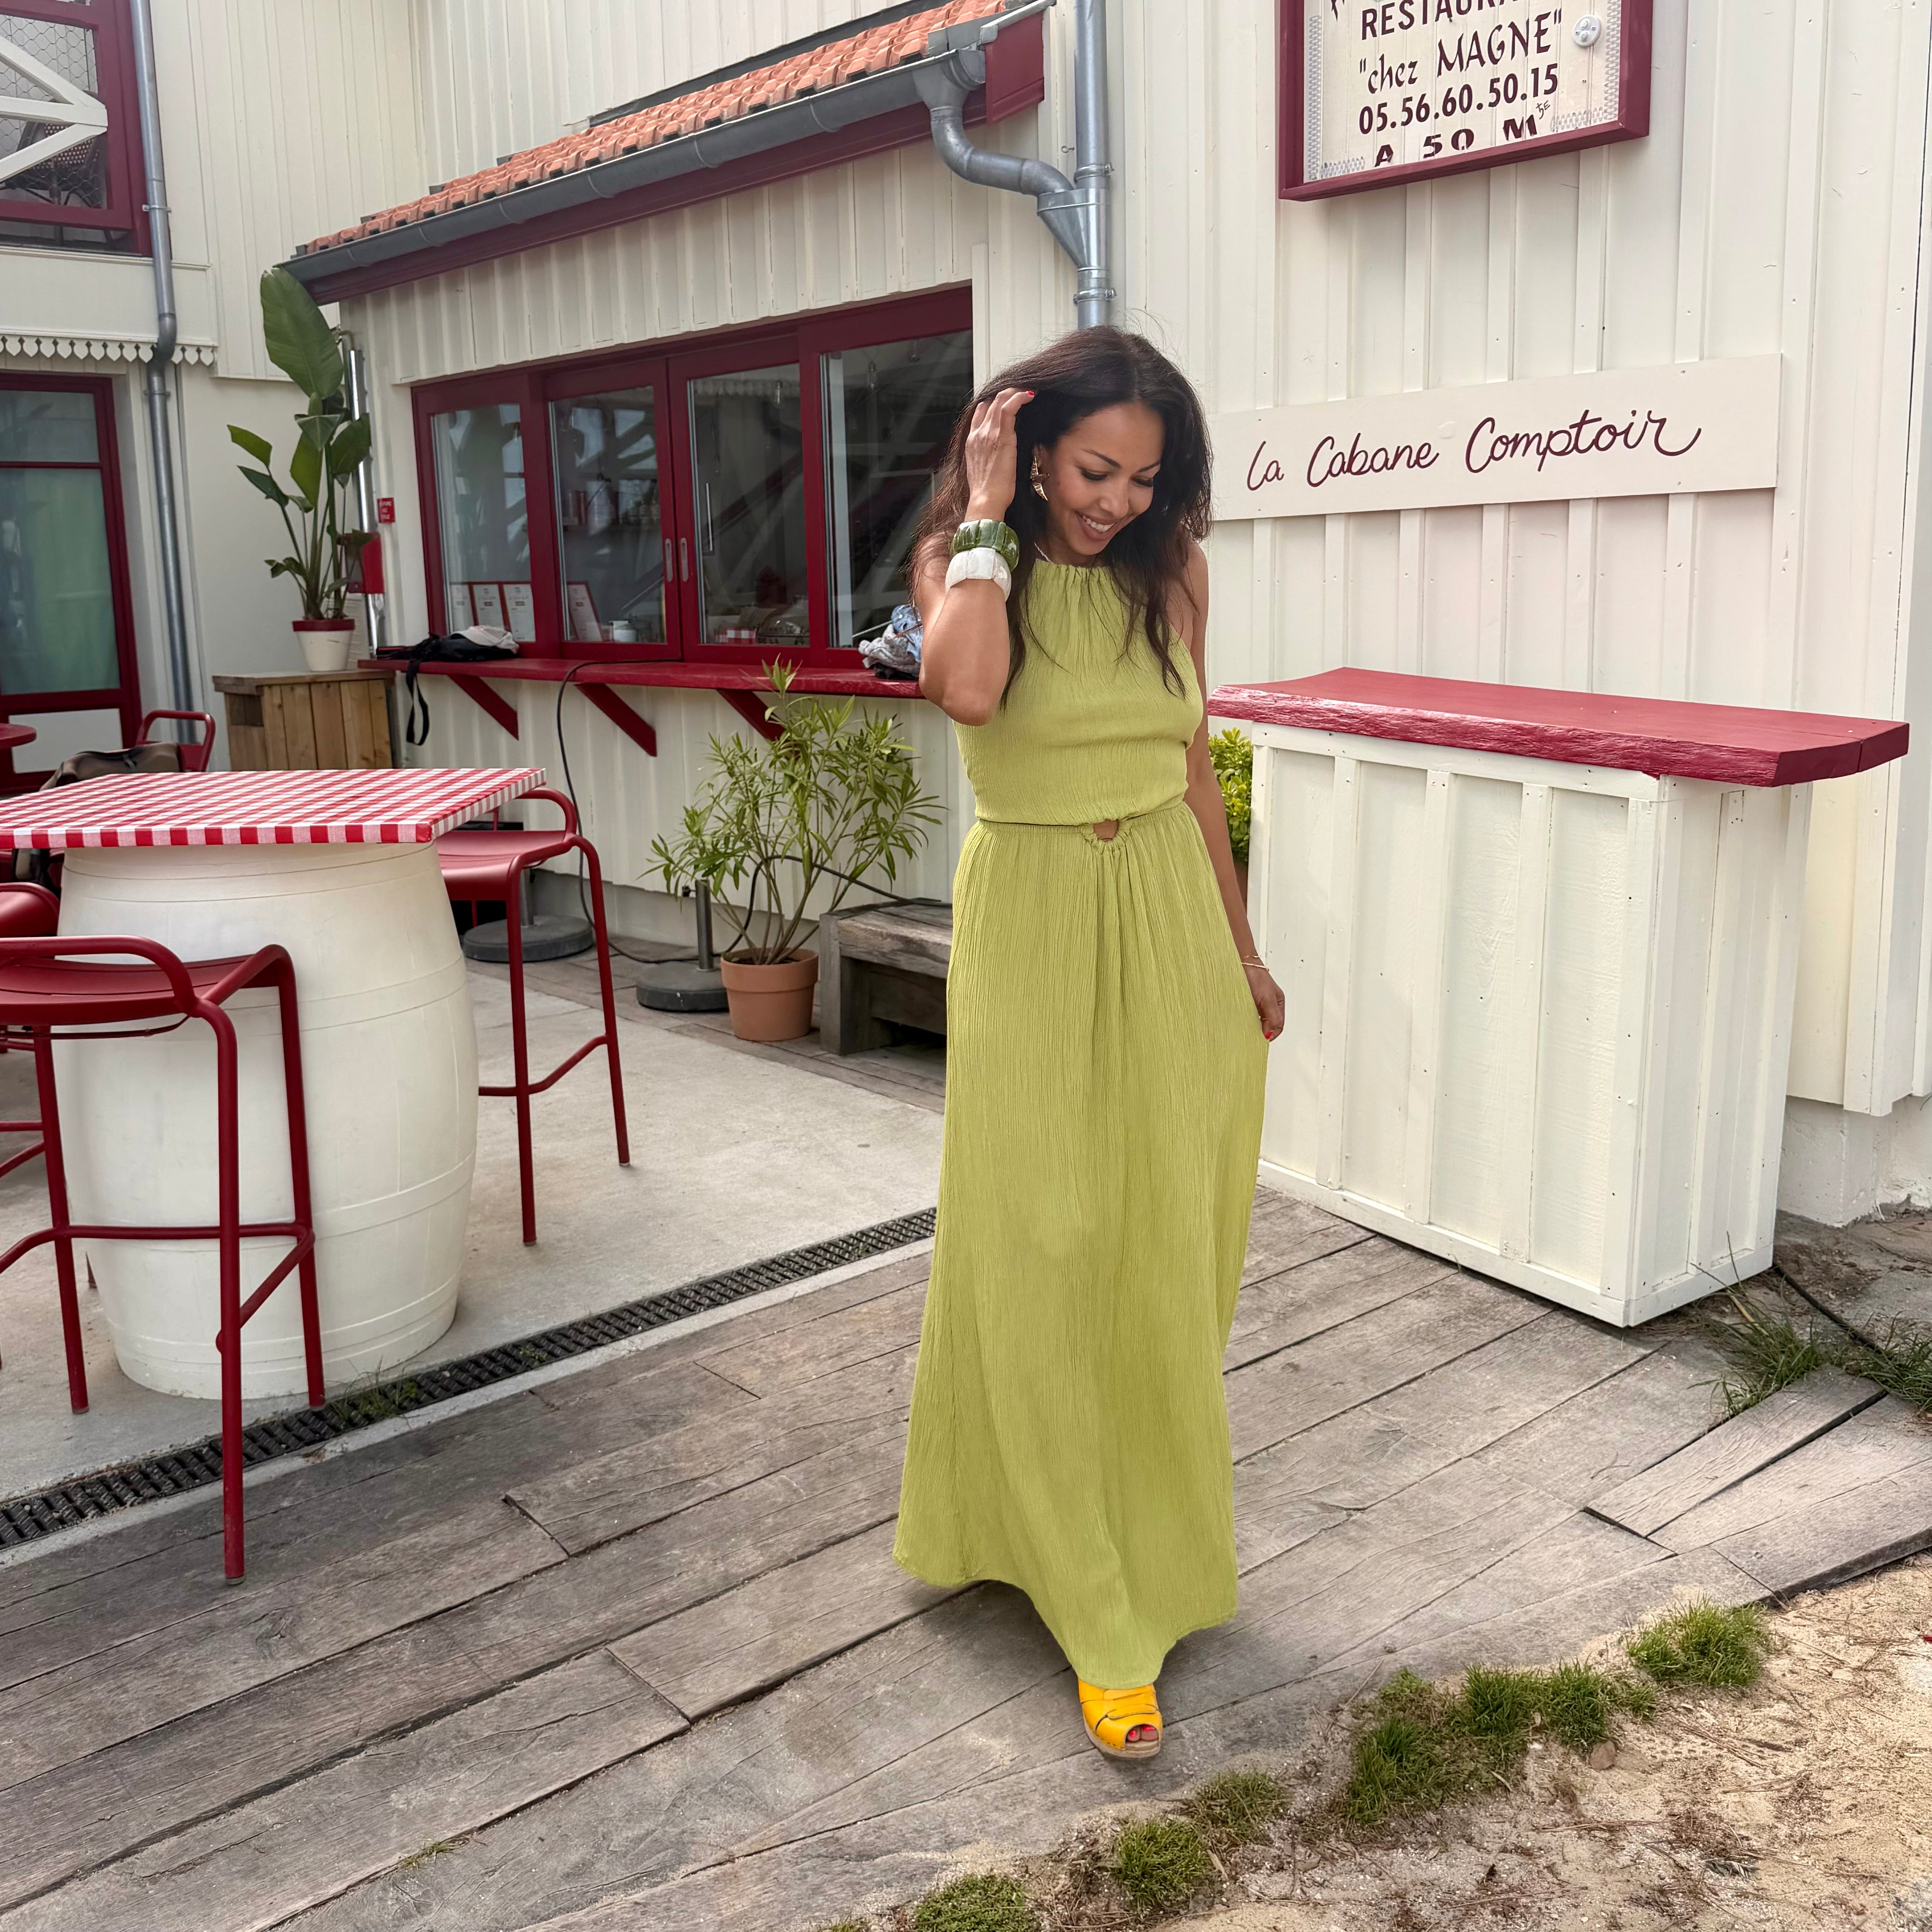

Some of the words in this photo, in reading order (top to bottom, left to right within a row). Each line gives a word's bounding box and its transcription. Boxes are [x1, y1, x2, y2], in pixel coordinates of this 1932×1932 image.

[1360, 53, 1418, 94] "chez
[1437, 9, 1562, 78] MAGNE"
[1361, 0, 1518, 40] RESTAU
[1359, 63, 1559, 135] 05.56.60.50.15
[1374, 144, 1394, 167] A
[1423, 129, 1474, 158] 50
[1503, 114, 1538, 141] M
[1247, 441, 1285, 491] La
[1307, 432, 1440, 487] Cabane
[1465, 409, 1702, 473] Comptoir
